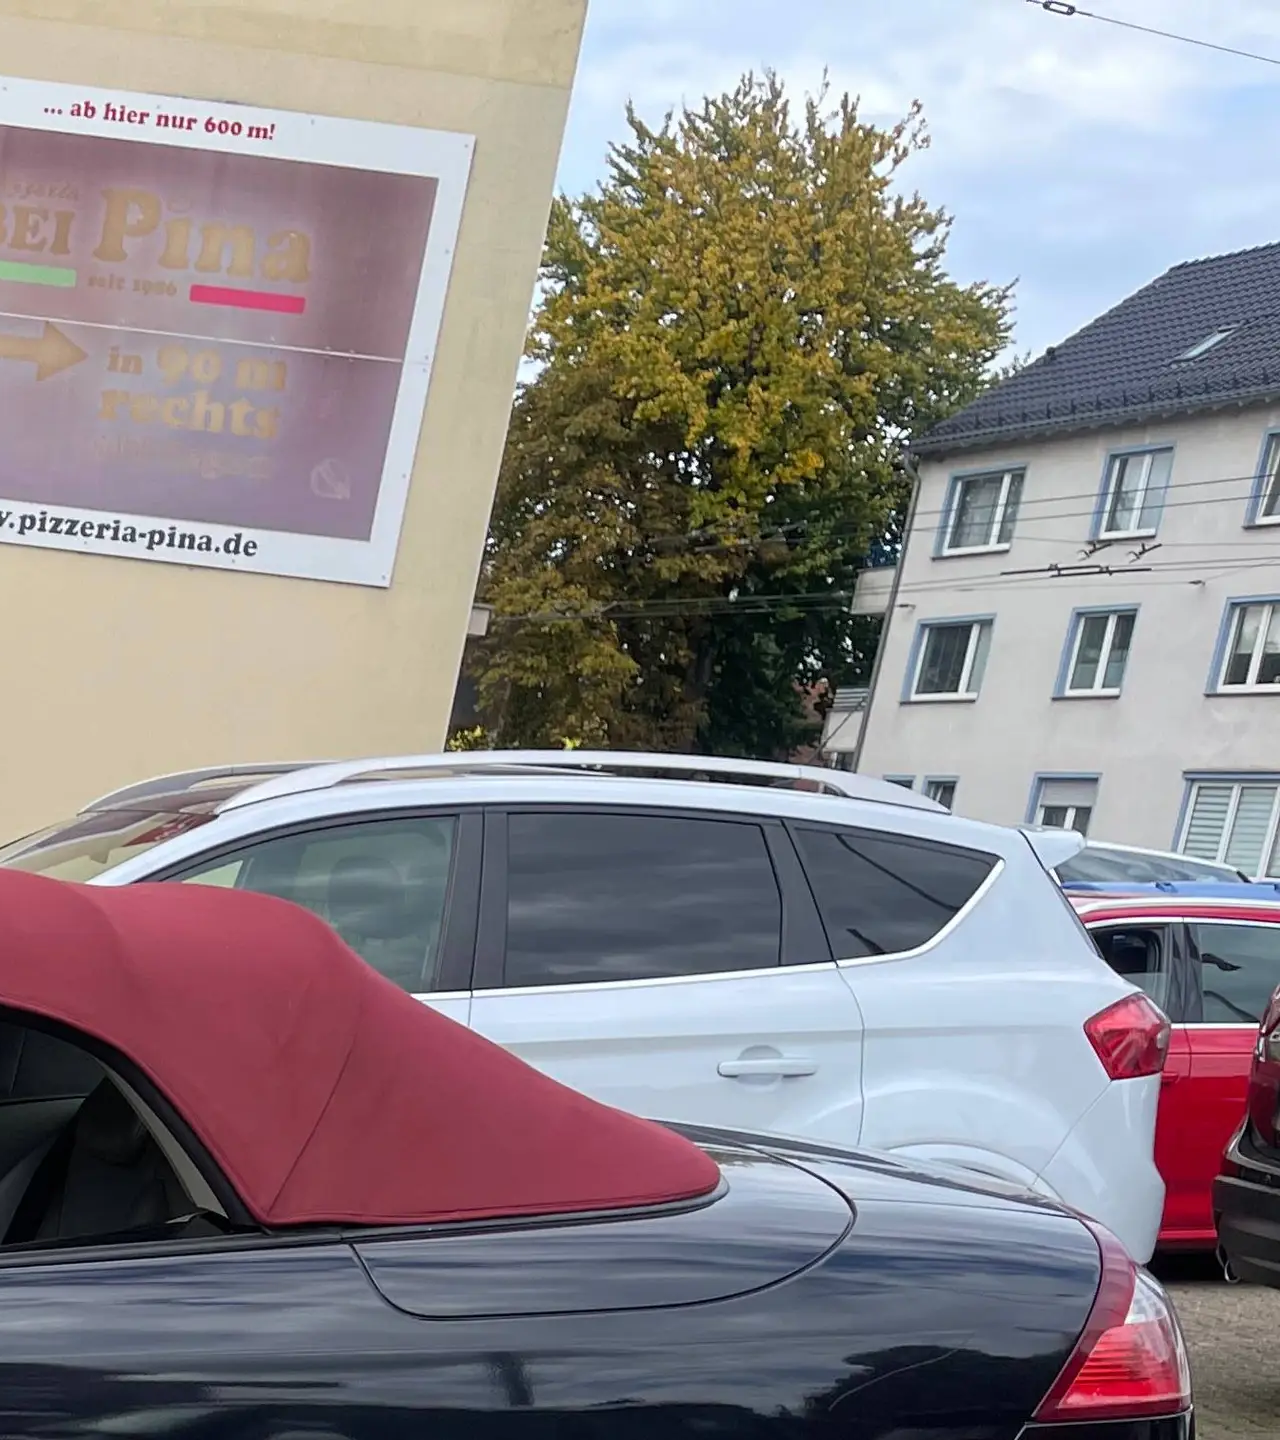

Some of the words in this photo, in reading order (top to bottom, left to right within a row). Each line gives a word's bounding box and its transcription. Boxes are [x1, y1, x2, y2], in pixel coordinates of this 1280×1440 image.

[70, 101, 96, 120] ab
[103, 102, 150, 125] hier
[155, 111, 198, 131] nur
[204, 116, 242, 136] 600
[246, 123, 276, 140] m!
[92, 187, 312, 283] Pina
[107, 346, 143, 375] in
[156, 342, 223, 386] 90
[236, 358, 288, 391] m
[98, 388, 281, 440] rechts
